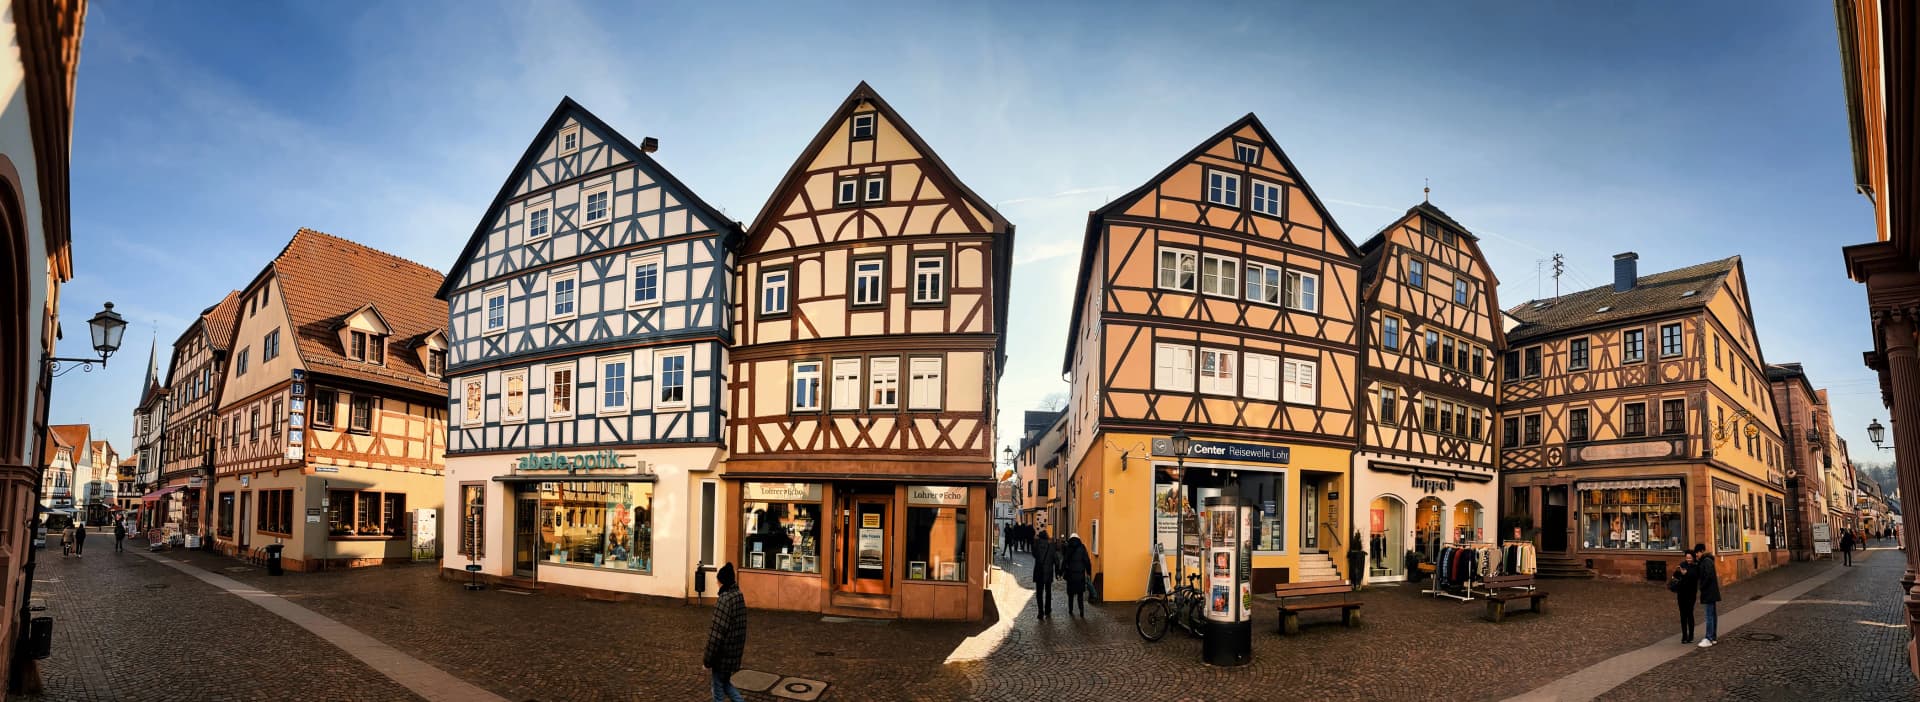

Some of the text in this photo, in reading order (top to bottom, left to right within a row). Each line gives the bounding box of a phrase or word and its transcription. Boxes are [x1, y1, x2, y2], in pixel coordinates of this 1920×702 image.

[292, 384, 302, 443] BANK
[1194, 443, 1226, 455] Center
[1229, 445, 1271, 458] Reisewelle
[1272, 449, 1288, 460] Lohr
[787, 488, 803, 496] Echo
[913, 490, 962, 500] Lohrer Echo
